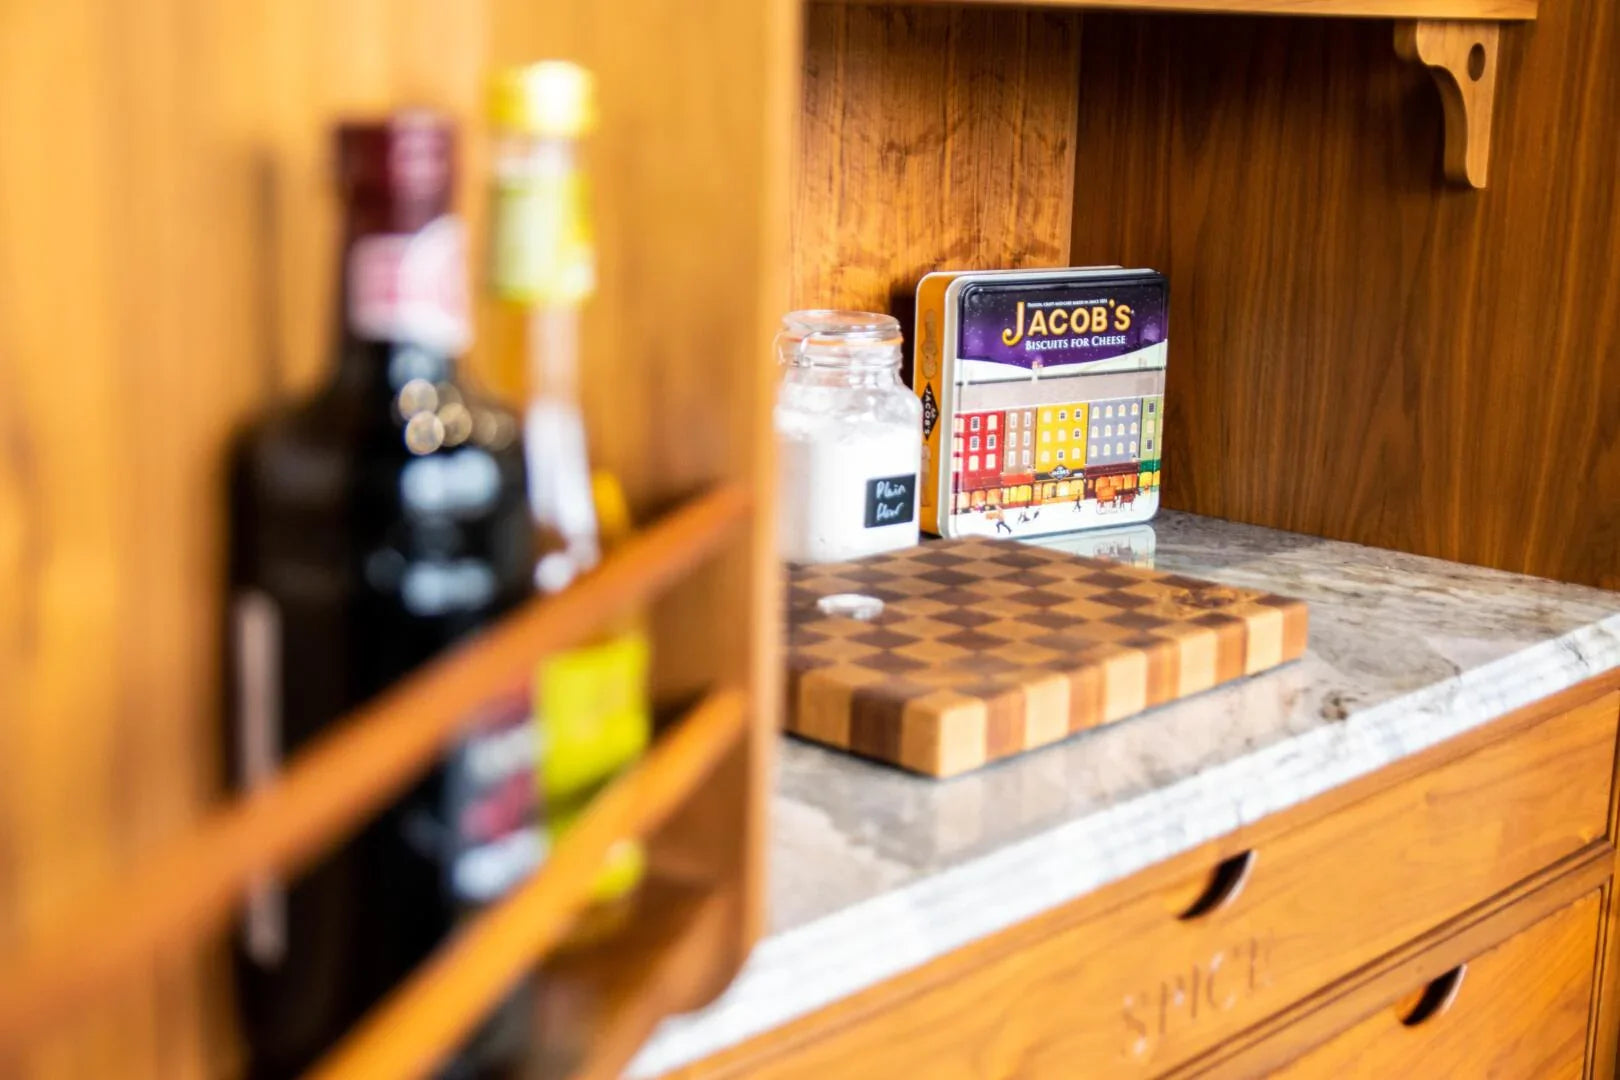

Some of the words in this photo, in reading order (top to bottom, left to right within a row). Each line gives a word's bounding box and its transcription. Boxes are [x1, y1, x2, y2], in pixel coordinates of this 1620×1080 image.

[1002, 299, 1132, 346] JACOB'S
[1025, 338, 1068, 351] BISCUITS
[1071, 337, 1090, 347] FOR
[1091, 335, 1126, 346] CHEESE
[924, 388, 932, 435] JACOB'S
[876, 480, 906, 499] Plain
